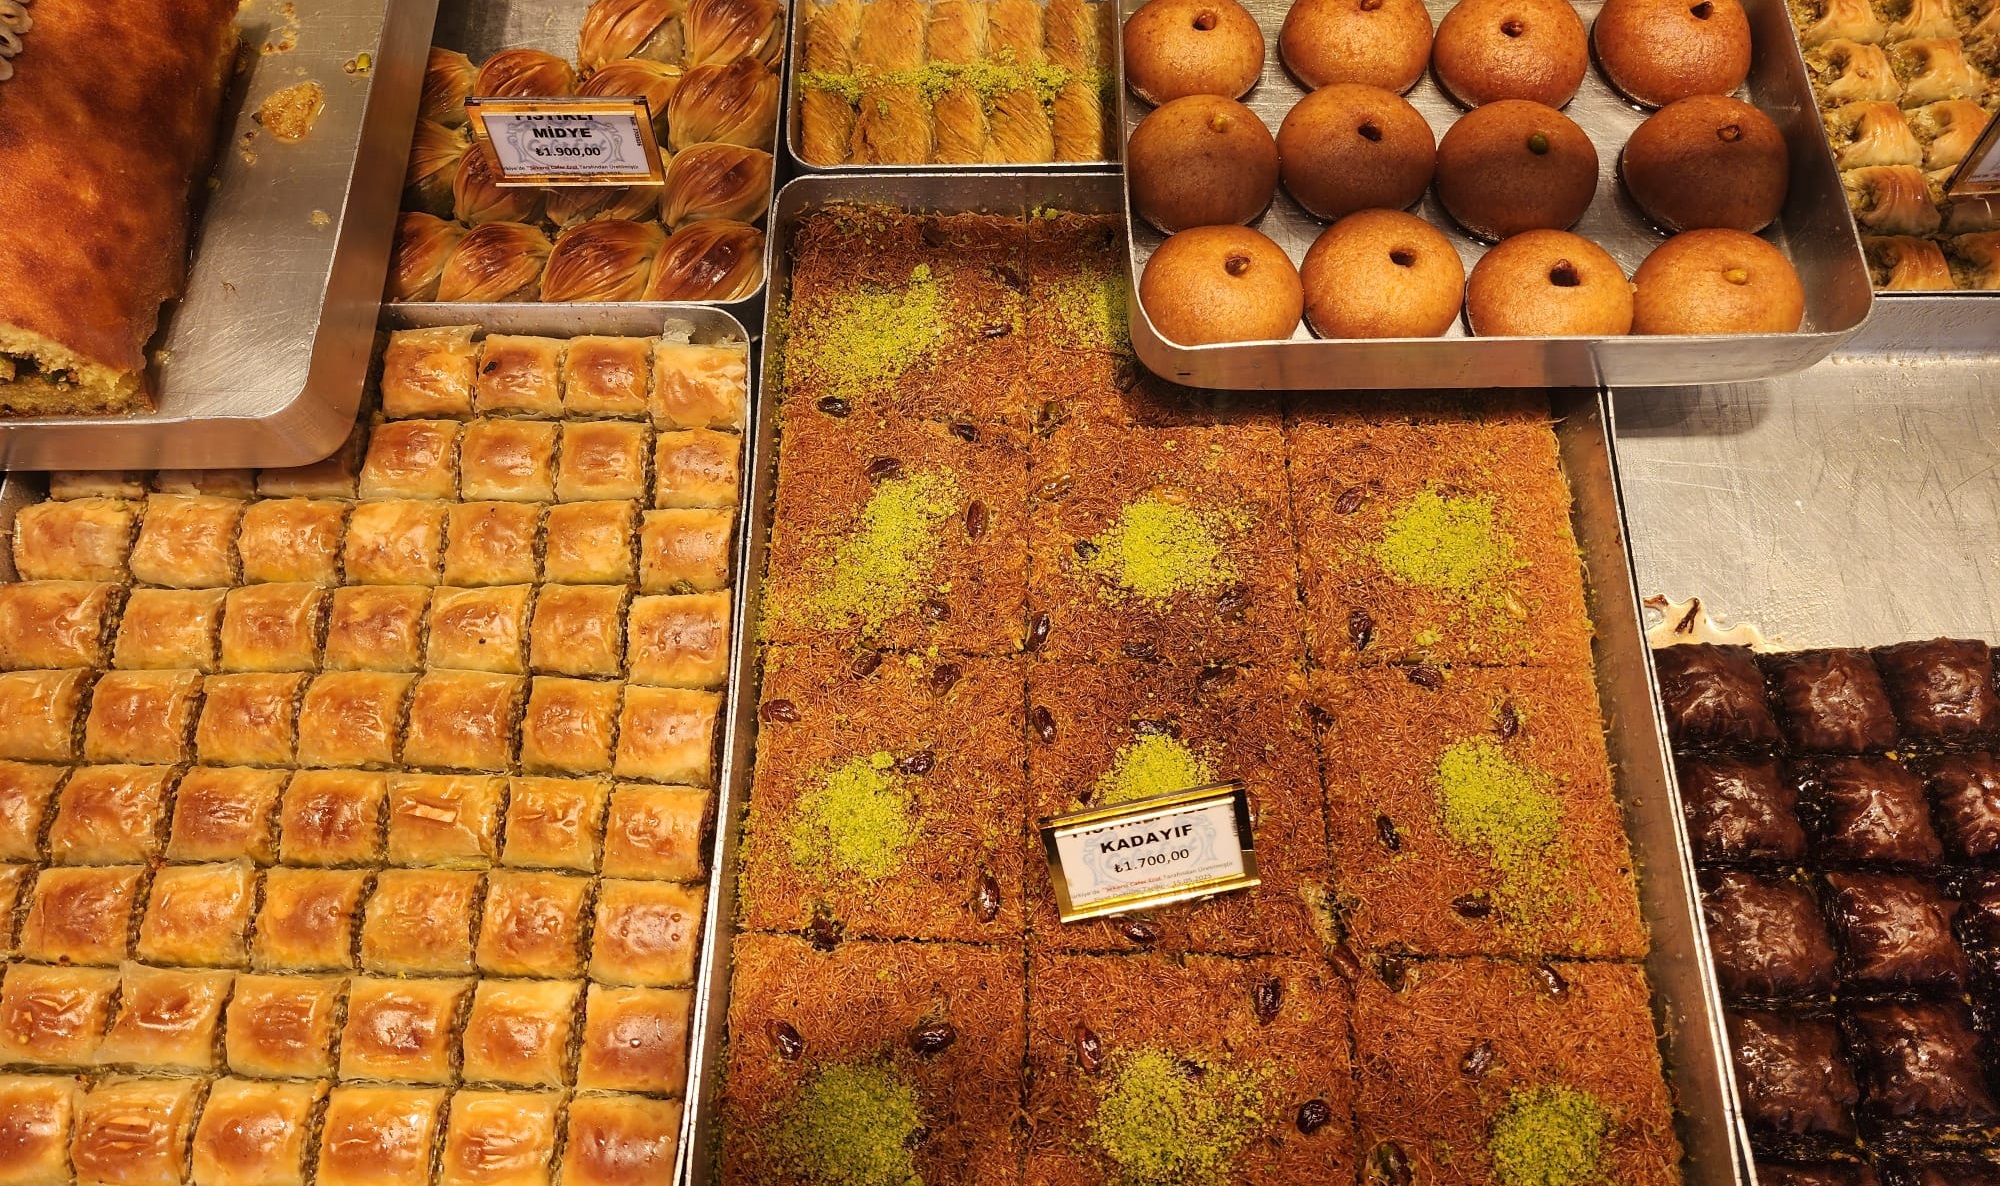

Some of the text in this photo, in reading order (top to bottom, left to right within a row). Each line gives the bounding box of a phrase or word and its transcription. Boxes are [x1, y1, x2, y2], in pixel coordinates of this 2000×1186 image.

[532, 126, 592, 138] MİDYE
[535, 147, 601, 158] ₺1.900,00
[1100, 824, 1193, 854] KADAYIF
[1113, 848, 1190, 873] ₺1.700,00
